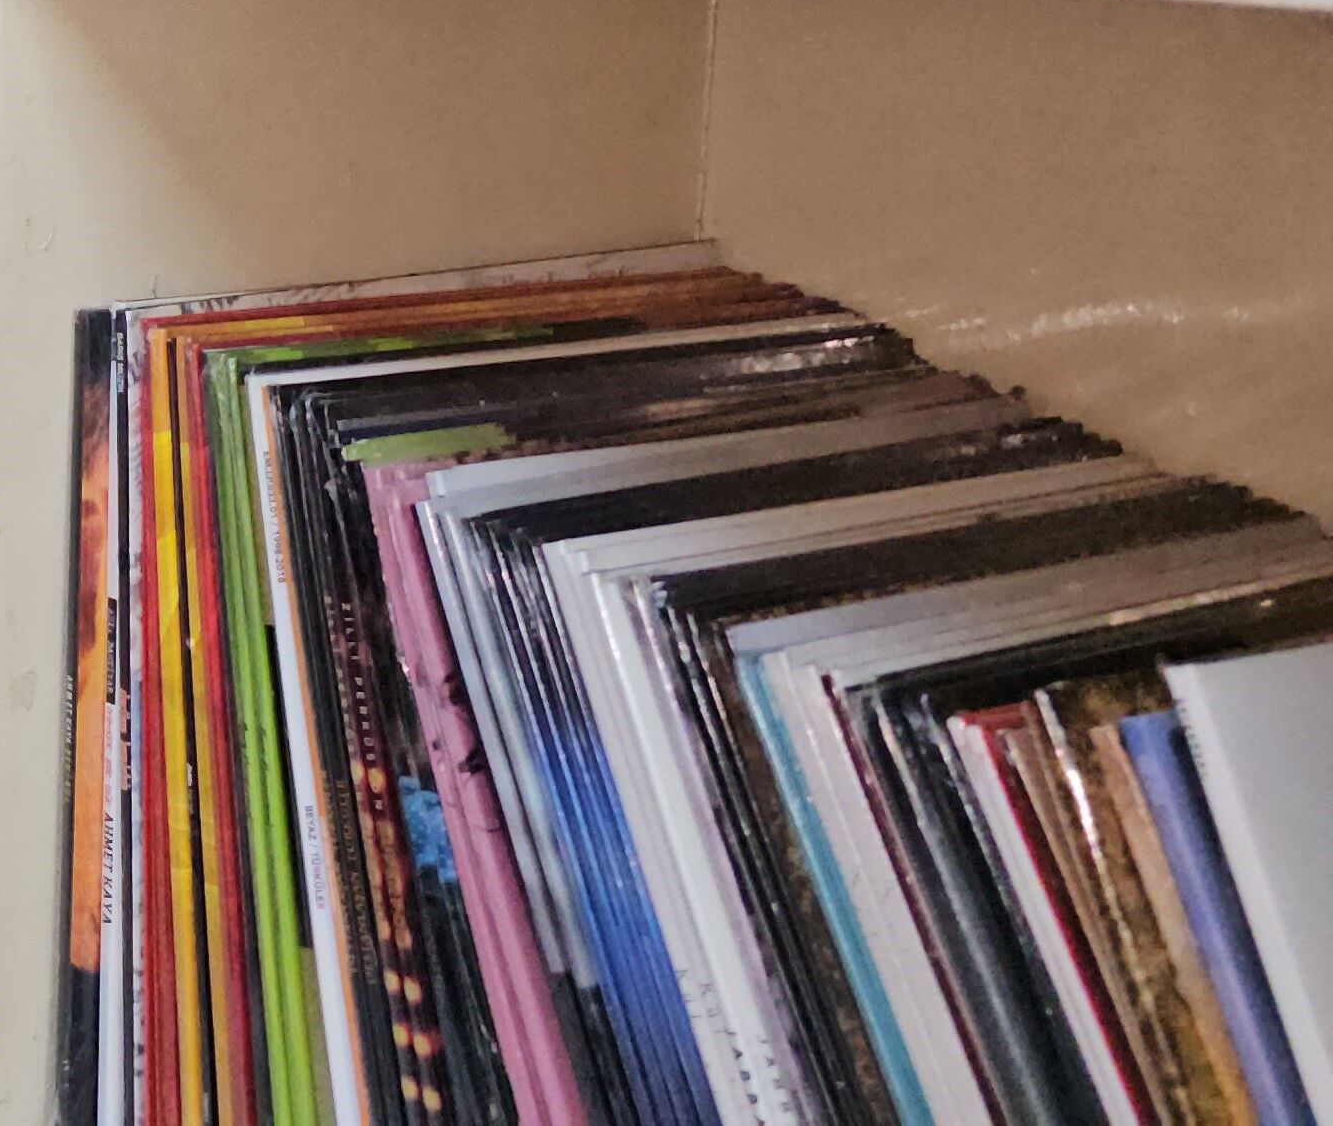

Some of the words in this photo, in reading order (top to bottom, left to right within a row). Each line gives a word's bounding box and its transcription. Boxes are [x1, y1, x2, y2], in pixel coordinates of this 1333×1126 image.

[103, 813, 114, 872] AHMET
[304, 805, 317, 841] BEYAZ
[311, 851, 326, 910] TÜRKÜLER
[102, 875, 113, 925] KAYA
